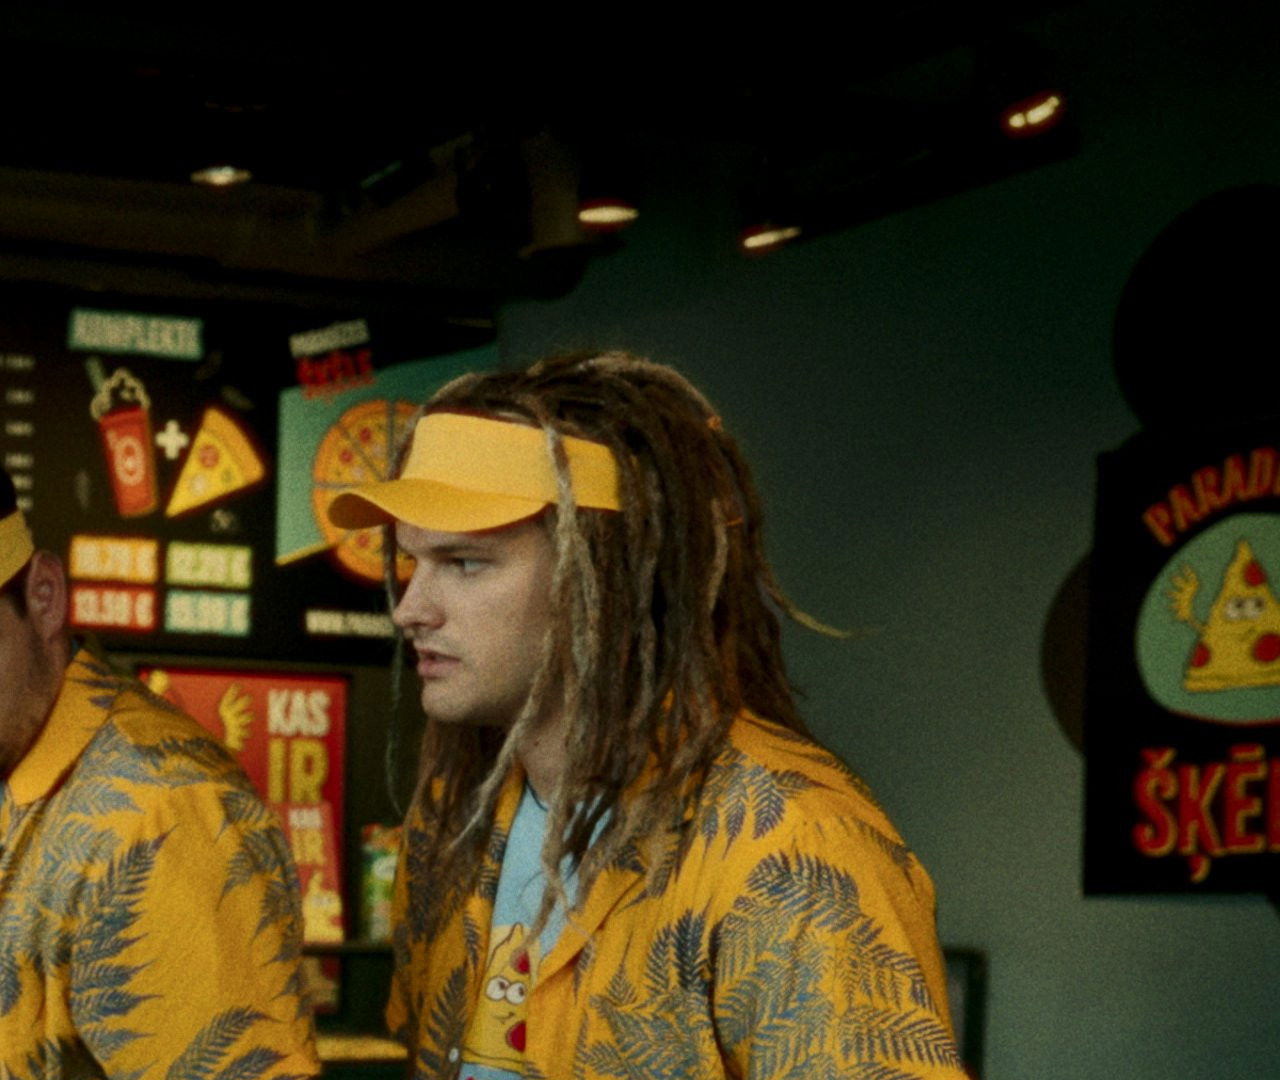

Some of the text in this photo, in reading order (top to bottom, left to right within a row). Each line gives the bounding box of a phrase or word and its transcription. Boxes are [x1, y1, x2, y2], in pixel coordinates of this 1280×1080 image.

[1142, 445, 1280, 547] PARAD
[268, 689, 330, 737] KAS
[267, 738, 329, 803] IR
